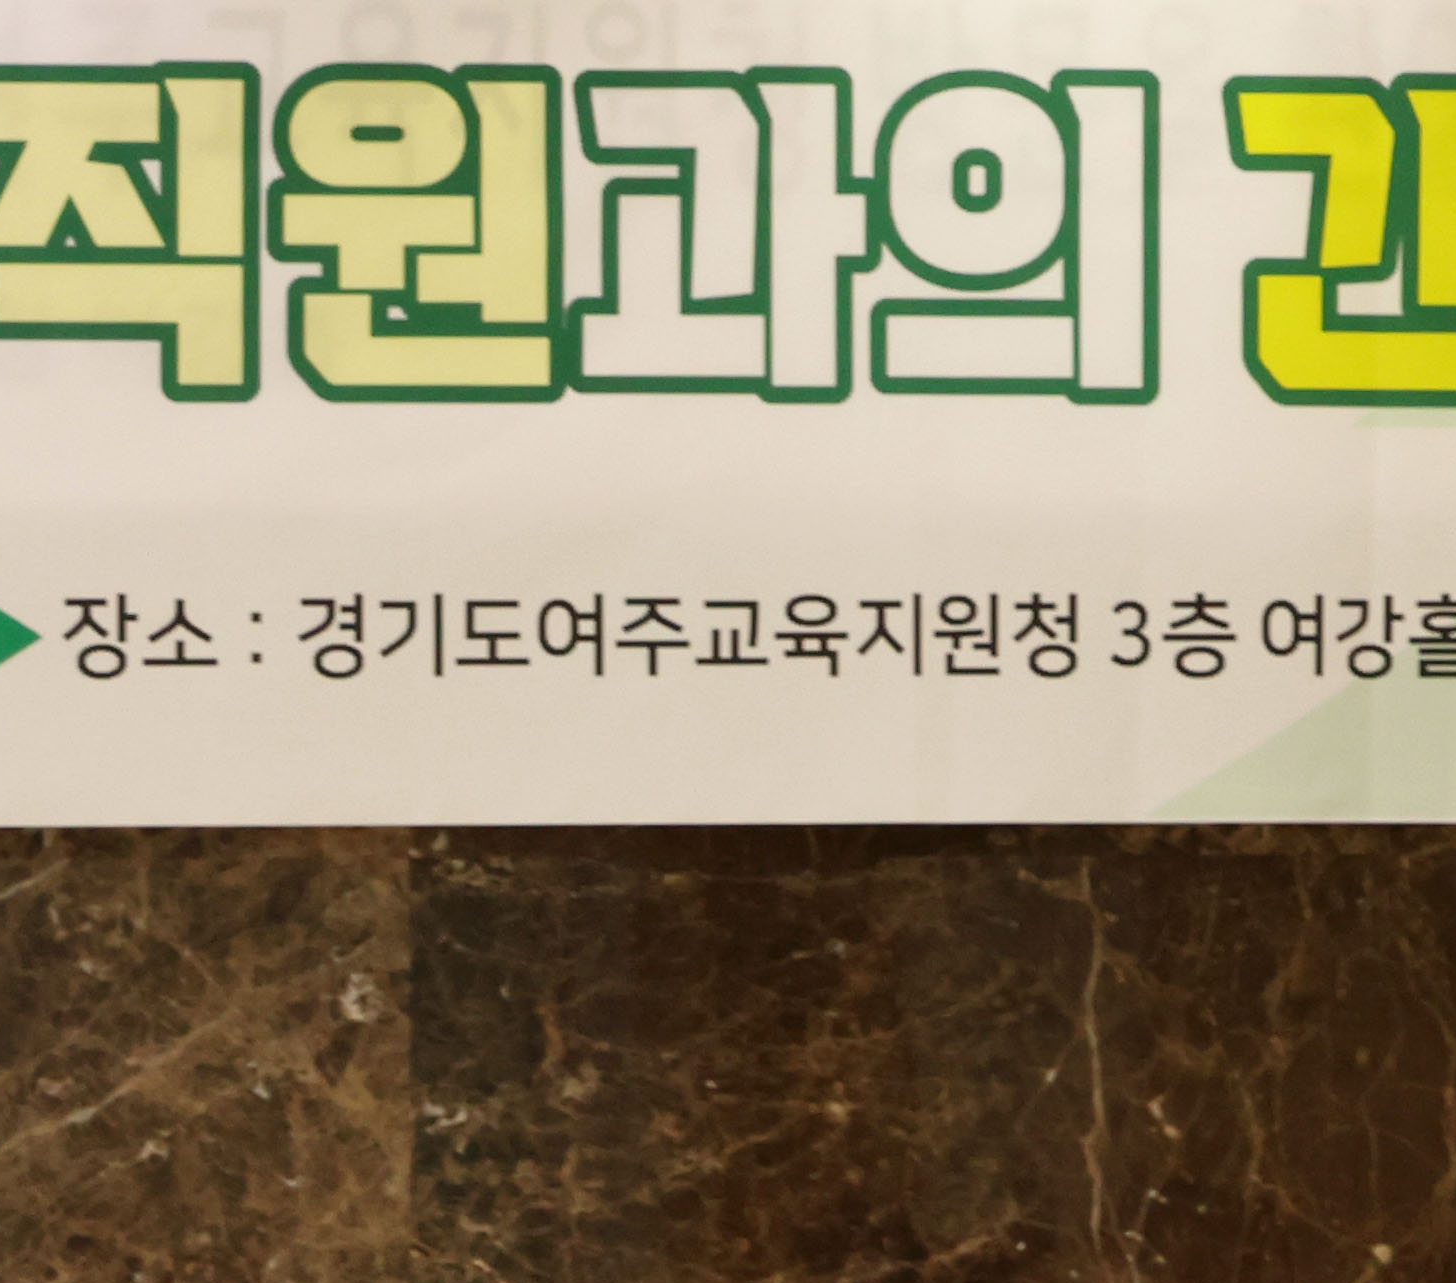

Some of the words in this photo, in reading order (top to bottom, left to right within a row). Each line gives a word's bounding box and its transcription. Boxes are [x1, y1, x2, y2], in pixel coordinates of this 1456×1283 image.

[63, 593, 219, 680] 장소
[298, 592, 1078, 680] 경기도여주교육지원청
[1110, 592, 1237, 679] 3층
